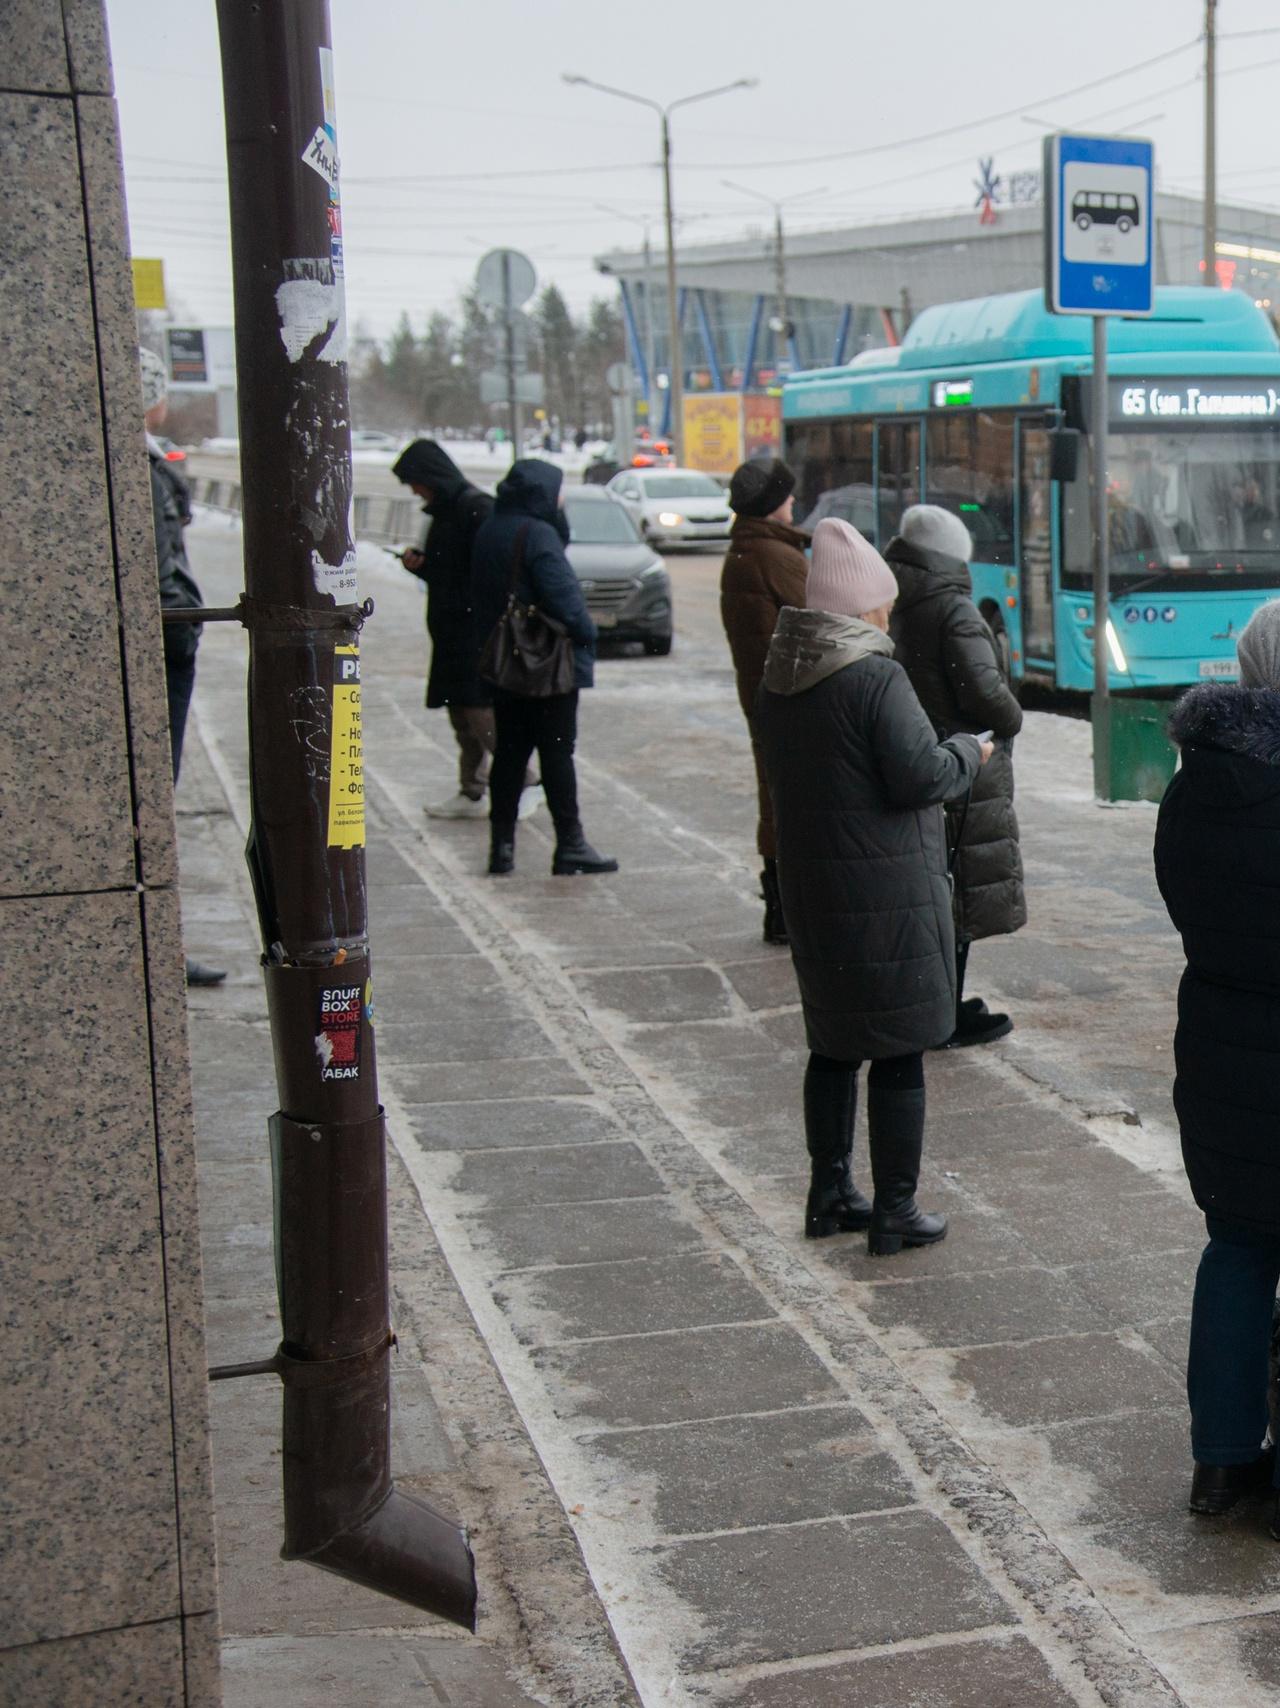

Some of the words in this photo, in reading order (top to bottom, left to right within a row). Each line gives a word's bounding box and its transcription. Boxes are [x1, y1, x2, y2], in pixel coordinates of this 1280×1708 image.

[1122, 388, 1146, 415] 65
[322, 1001, 350, 1011] BOX
[322, 1011, 360, 1023] STORE
[322, 1066, 359, 1080] АБАК
